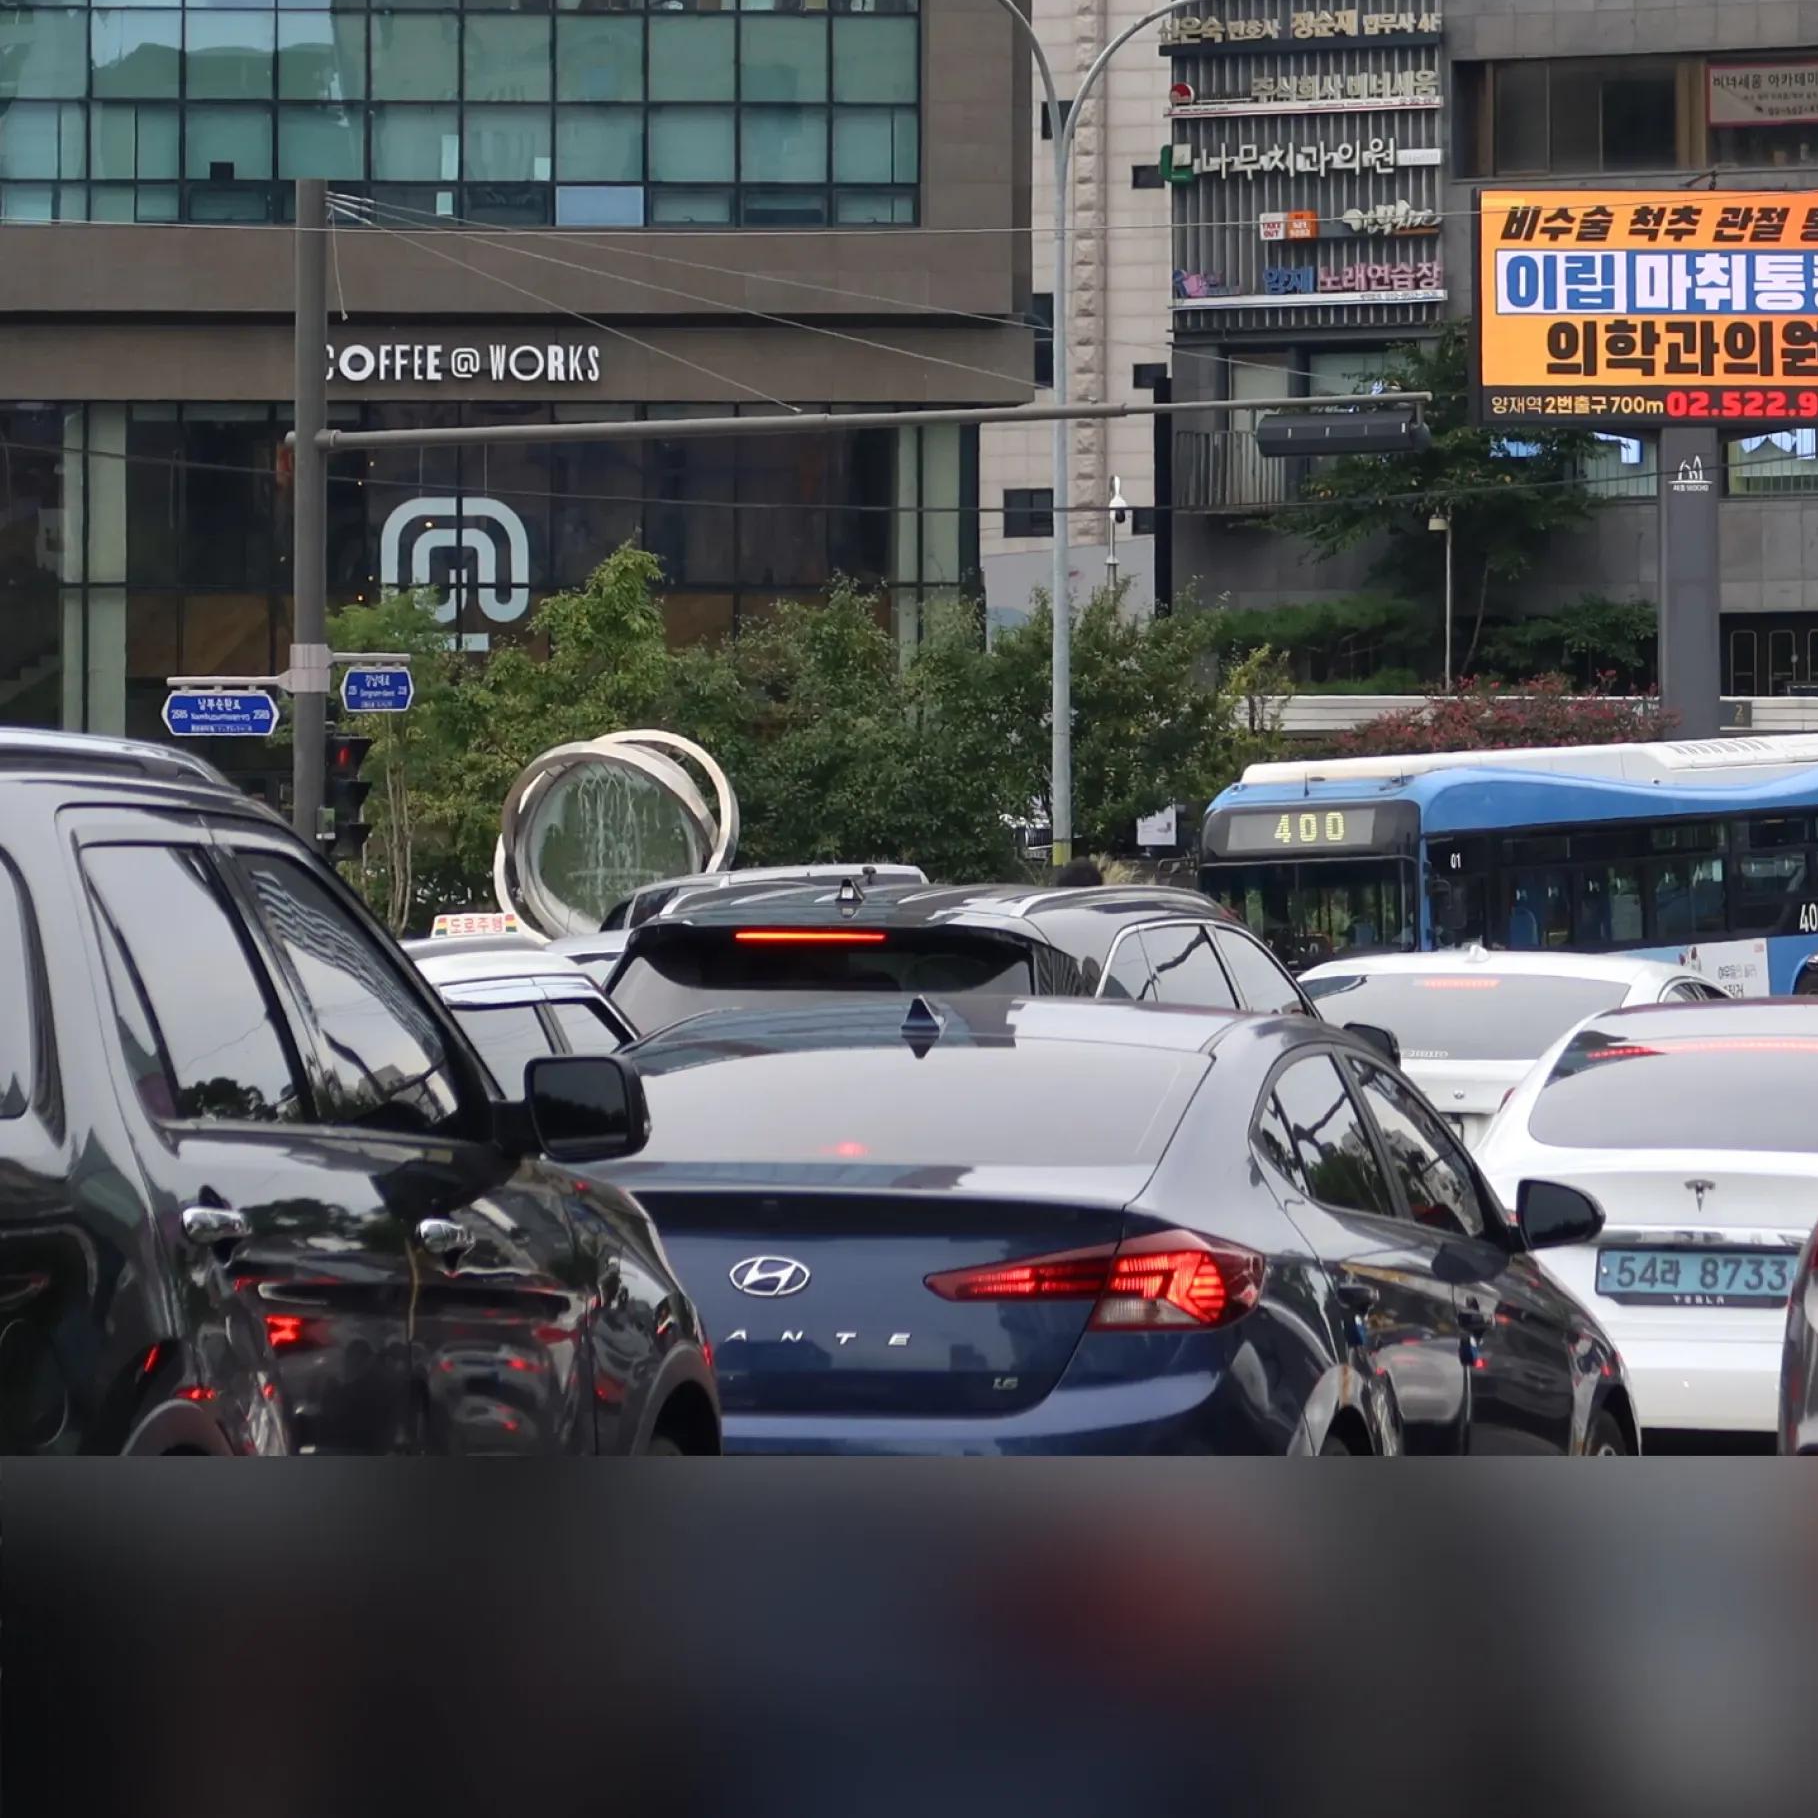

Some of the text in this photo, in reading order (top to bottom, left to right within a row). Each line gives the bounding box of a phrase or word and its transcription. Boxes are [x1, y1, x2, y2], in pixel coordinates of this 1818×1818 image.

[1201, 137, 1396, 181] 나무치과의원
[1499, 205, 1616, 243] 비수술
[1627, 205, 1703, 243] 척추
[1712, 205, 1791, 244] 관절
[1318, 260, 1443, 293] 노래연습장
[488, 344, 600, 382] WORKS
[1491, 394, 1542, 415] 양재역
[1544, 394, 1608, 415] 2번출구
[1610, 395, 1665, 414] 700m
[1274, 811, 1345, 844] 400
[1449, 852, 1462, 870] 01
[1616, 1255, 1789, 1291] 54라 8733
